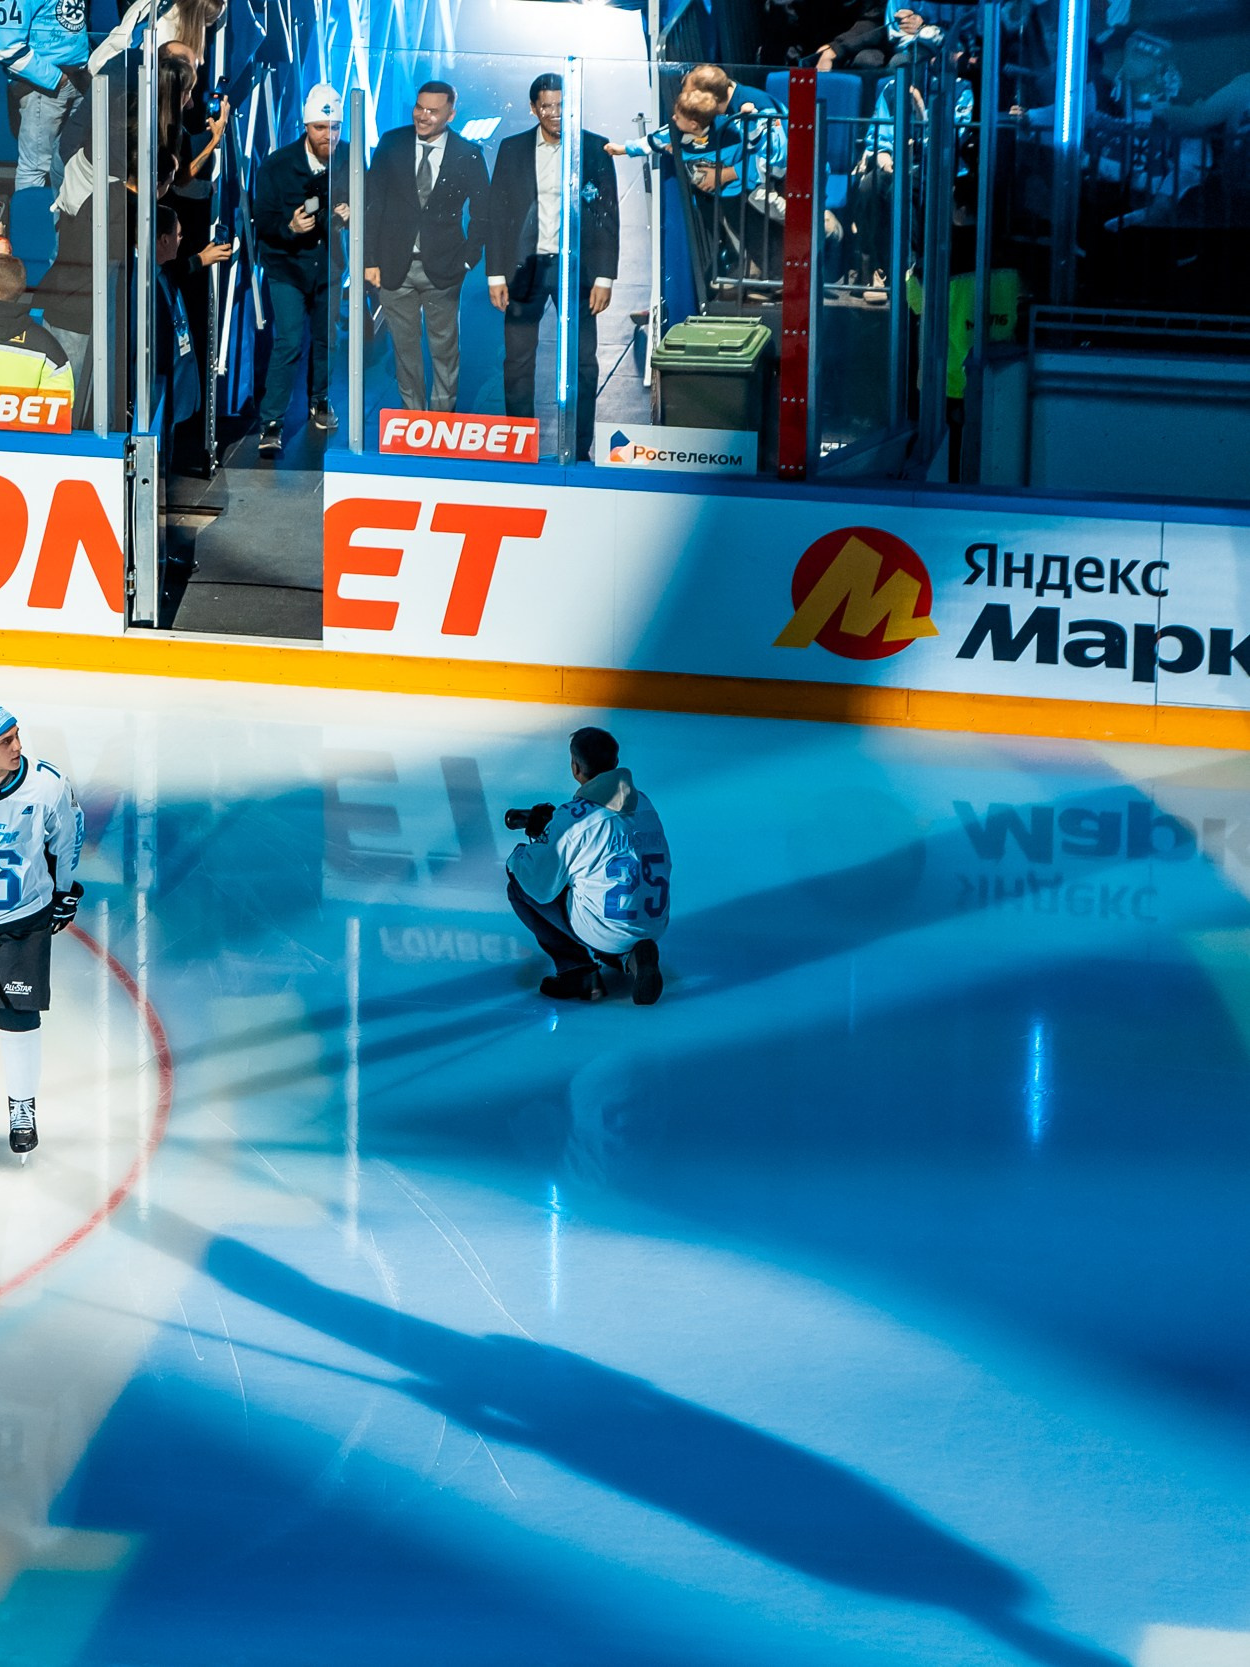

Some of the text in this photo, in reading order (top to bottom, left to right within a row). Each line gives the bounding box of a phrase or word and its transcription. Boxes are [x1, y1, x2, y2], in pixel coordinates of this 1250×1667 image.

[382, 417, 536, 455] FONBET
[633, 445, 743, 466] Ростелеком
[963, 542, 1170, 599] Яндекс
[603, 853, 669, 920] 25
